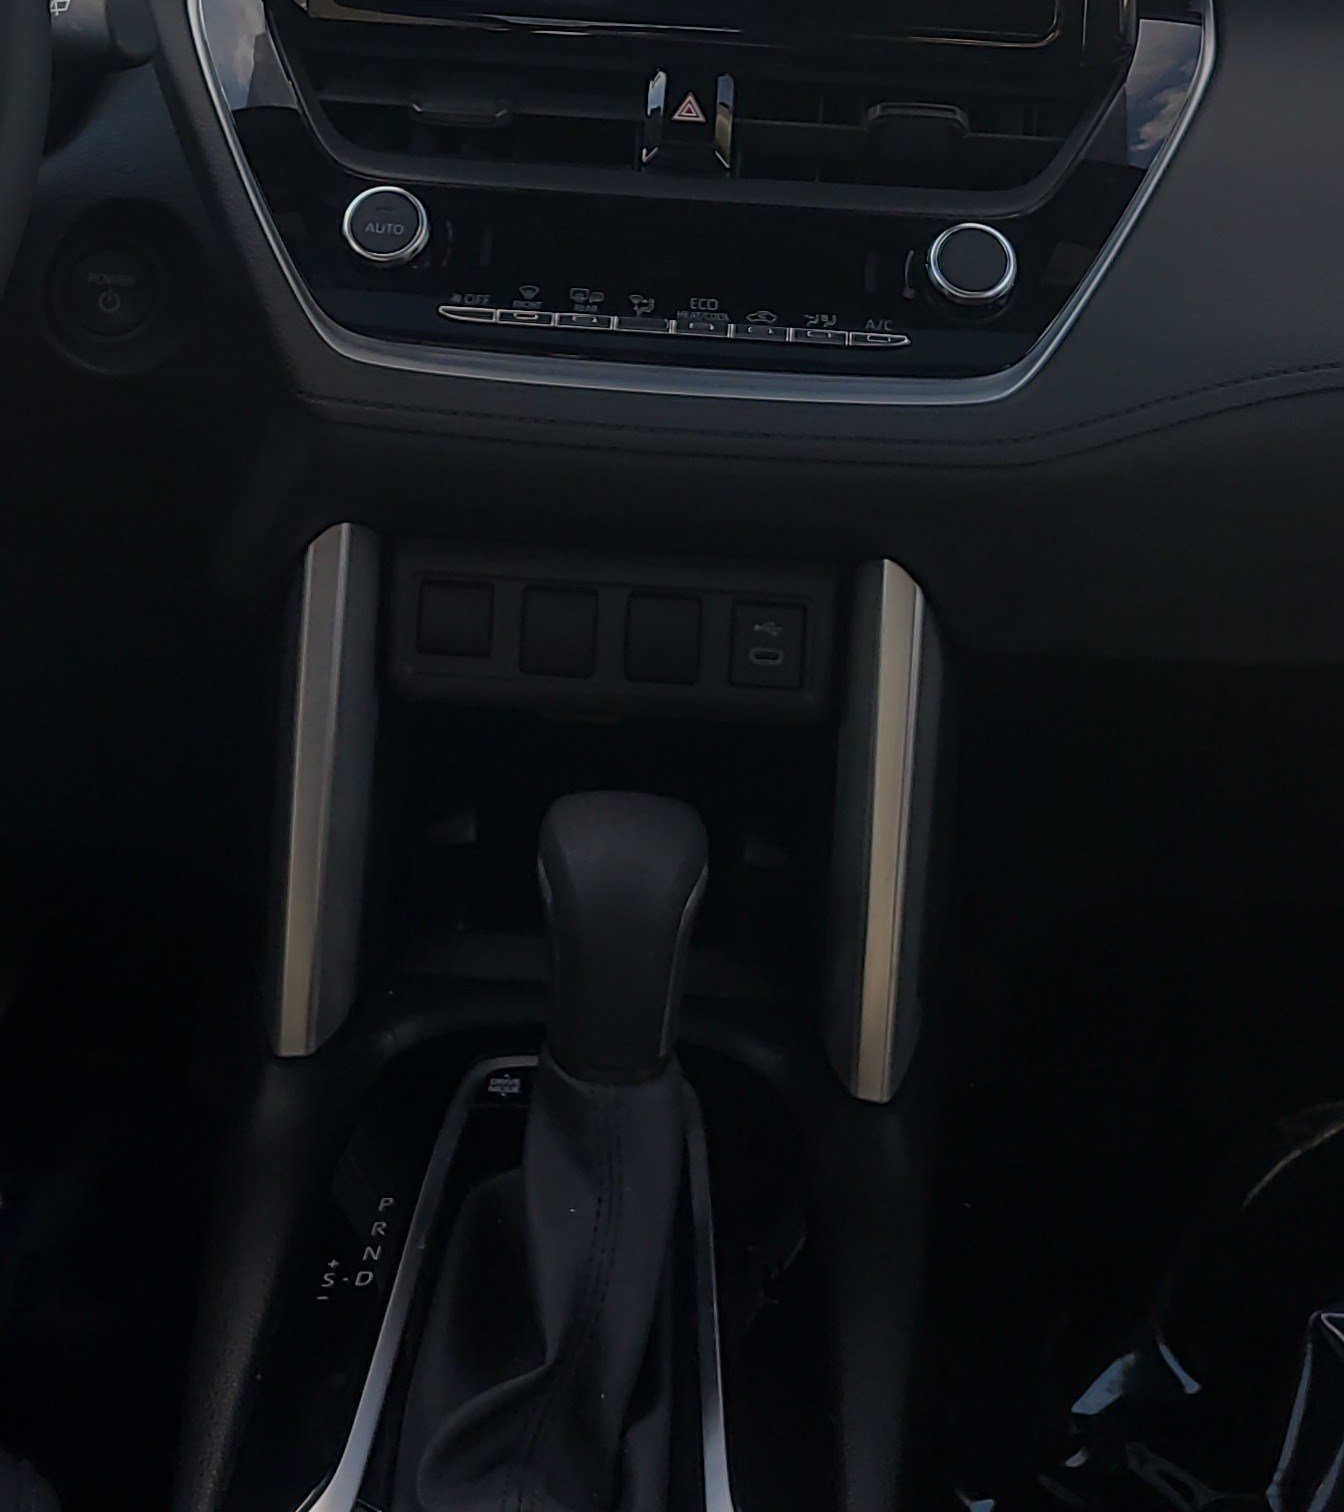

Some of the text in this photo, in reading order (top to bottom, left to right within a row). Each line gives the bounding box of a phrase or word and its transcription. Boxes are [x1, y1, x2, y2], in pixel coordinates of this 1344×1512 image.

[364, 221, 405, 236] AUTO
[463, 293, 492, 305] OFF
[689, 297, 719, 311] ECO
[865, 318, 893, 332] A/C
[378, 1197, 394, 1211] P
[371, 1221, 387, 1236] R
[362, 1245, 382, 1261] N
[321, 1270, 374, 1288] S D
